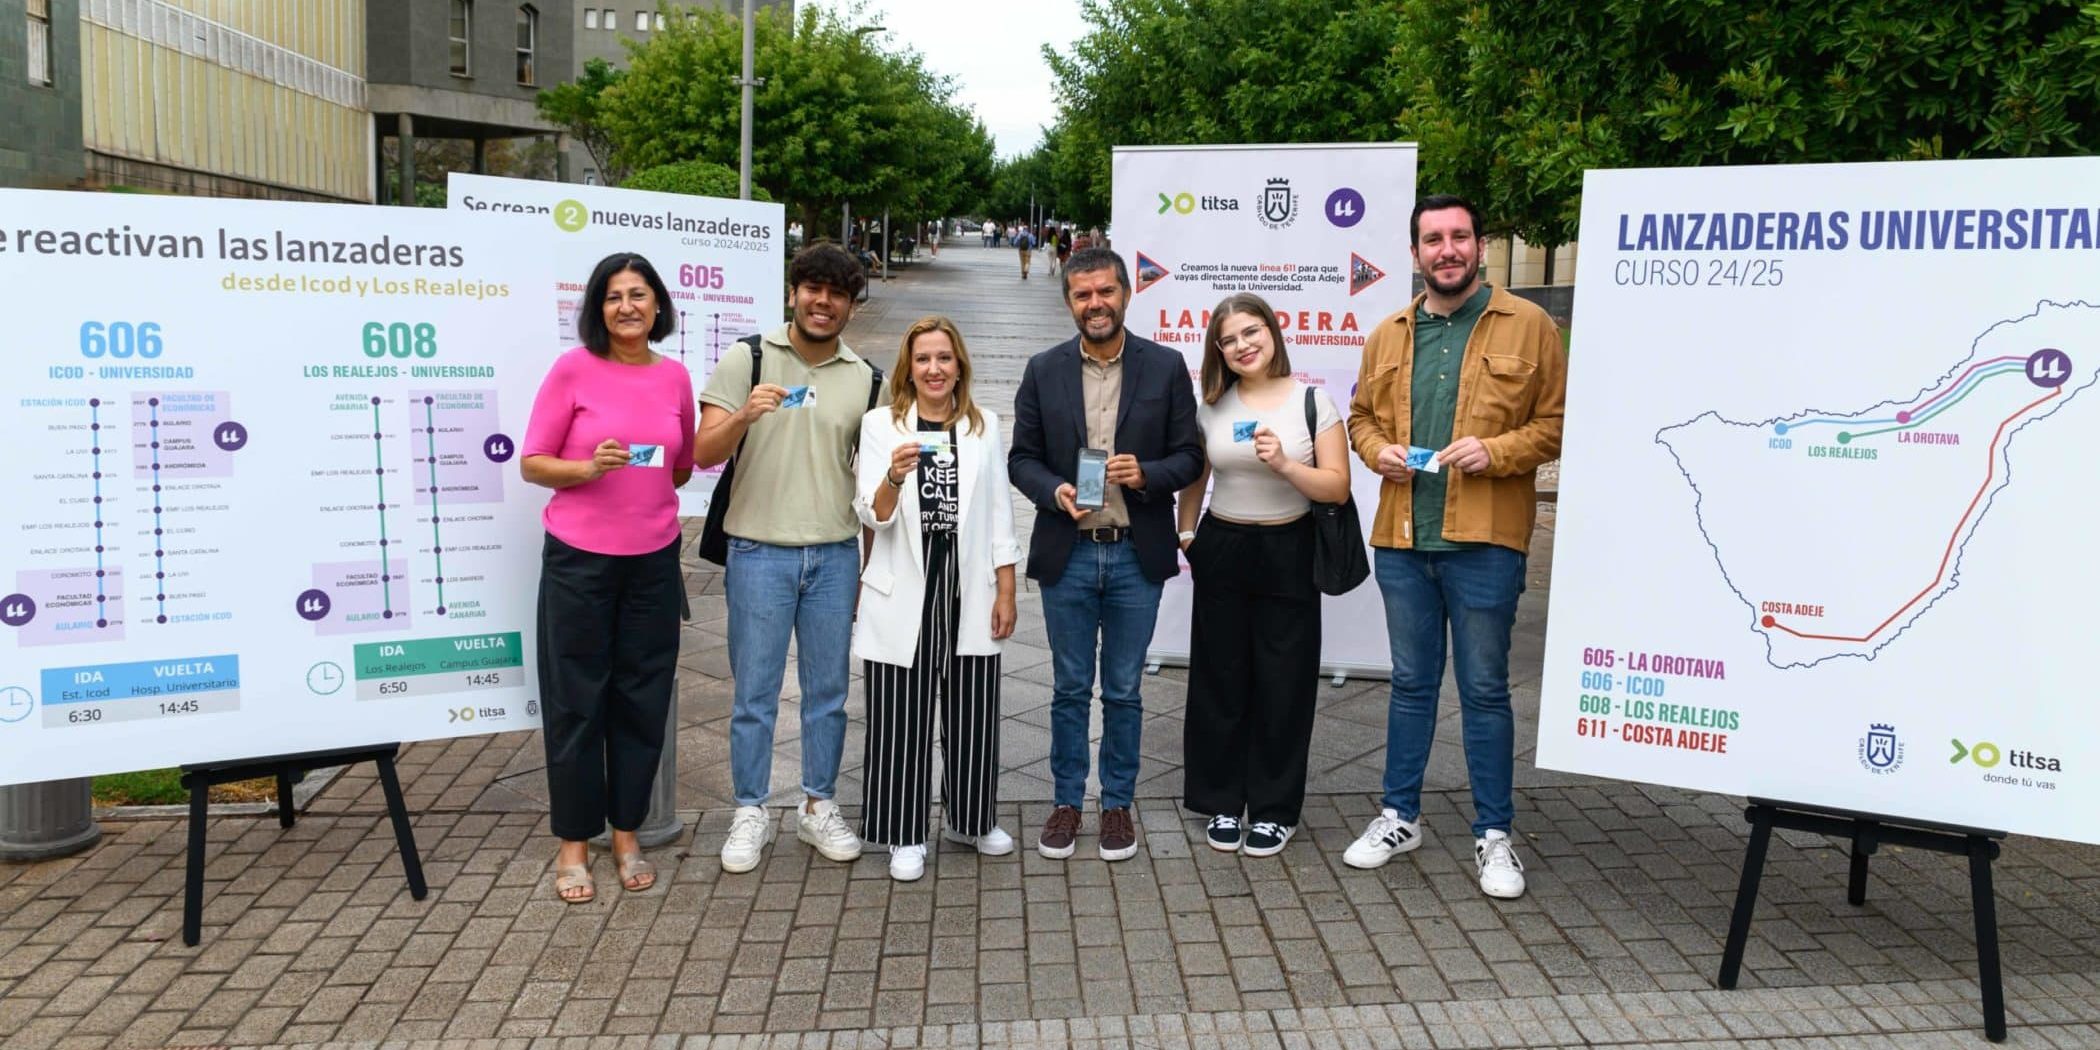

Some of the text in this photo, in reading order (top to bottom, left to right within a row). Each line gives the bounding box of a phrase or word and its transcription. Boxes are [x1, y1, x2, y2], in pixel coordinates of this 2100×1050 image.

[1202, 196, 1239, 210] titsa
[564, 206, 578, 225] 2
[592, 209, 663, 230] nuevas
[667, 212, 770, 239] lanzaderas
[1617, 208, 2100, 251] LANZADERAS UNIVERSITA
[16, 226, 204, 259] reactivan
[219, 228, 268, 261] las
[276, 231, 464, 268] lanzaderas
[682, 238, 769, 252] curso 2024/2025
[680, 264, 724, 289] 605
[1174, 273, 1345, 284] vayas directamente desde Costa Adeje
[1180, 264, 1219, 272] Creamos
[1221, 264, 1228, 272] la
[1284, 264, 1296, 272] 611
[1298, 266, 1318, 275] para
[1320, 266, 1338, 275] que
[1614, 258, 1784, 286] CURSO 24/25
[222, 272, 510, 300] desde Icod y Los Realejos
[1212, 282, 1303, 292] hasta la Universidad.
[703, 294, 754, 304] UNIVERSIDAD
[80, 321, 162, 358] 606
[362, 322, 437, 358] 608
[1184, 332, 1200, 343] 611
[1296, 335, 1364, 346] UNIVERSIDAD
[50, 366, 84, 379] ICOD
[100, 366, 194, 379] UNIVERSIDAD
[304, 366, 328, 378] LOS
[333, 366, 398, 378] REALEJOS
[412, 366, 494, 378] UNIVERSIDAD
[1768, 438, 1792, 450] ICOD
[1898, 432, 1960, 446] LA OROTAVA
[1808, 446, 1878, 460] LOS REALEJOS
[924, 466, 956, 484] KEE
[921, 482, 958, 502] CAL
[920, 511, 935, 520] RY
[938, 502, 956, 512] AND
[1762, 601, 1824, 618] COSTA ADEJE
[379, 636, 506, 657] IDA VUELTA
[74, 662, 214, 684] IDA VUELTA
[366, 665, 382, 674] Los
[440, 660, 478, 671] Campus
[1583, 648, 1614, 668] 605
[1628, 652, 1648, 672] LA
[1652, 654, 1726, 680] OROTAVA
[62, 690, 84, 700] Est.
[86, 687, 110, 698] Icod
[166, 678, 237, 692] Universitario
[379, 674, 500, 694] 6:50 14:45
[1581, 671, 1612, 692] 606
[1626, 676, 1664, 698] ICOD
[68, 700, 199, 724] 6:30 14:45
[479, 706, 506, 718] titsa
[1579, 694, 1610, 716] 608
[1624, 700, 1654, 721] LOS
[1658, 704, 1740, 731] REALEJOS
[1578, 718, 1606, 738] 611
[1622, 723, 1674, 748] COSTA
[1677, 730, 1727, 754] ADEJE
[2010, 748, 2062, 772] titsa
[1984, 773, 2056, 790] donde tú vas
